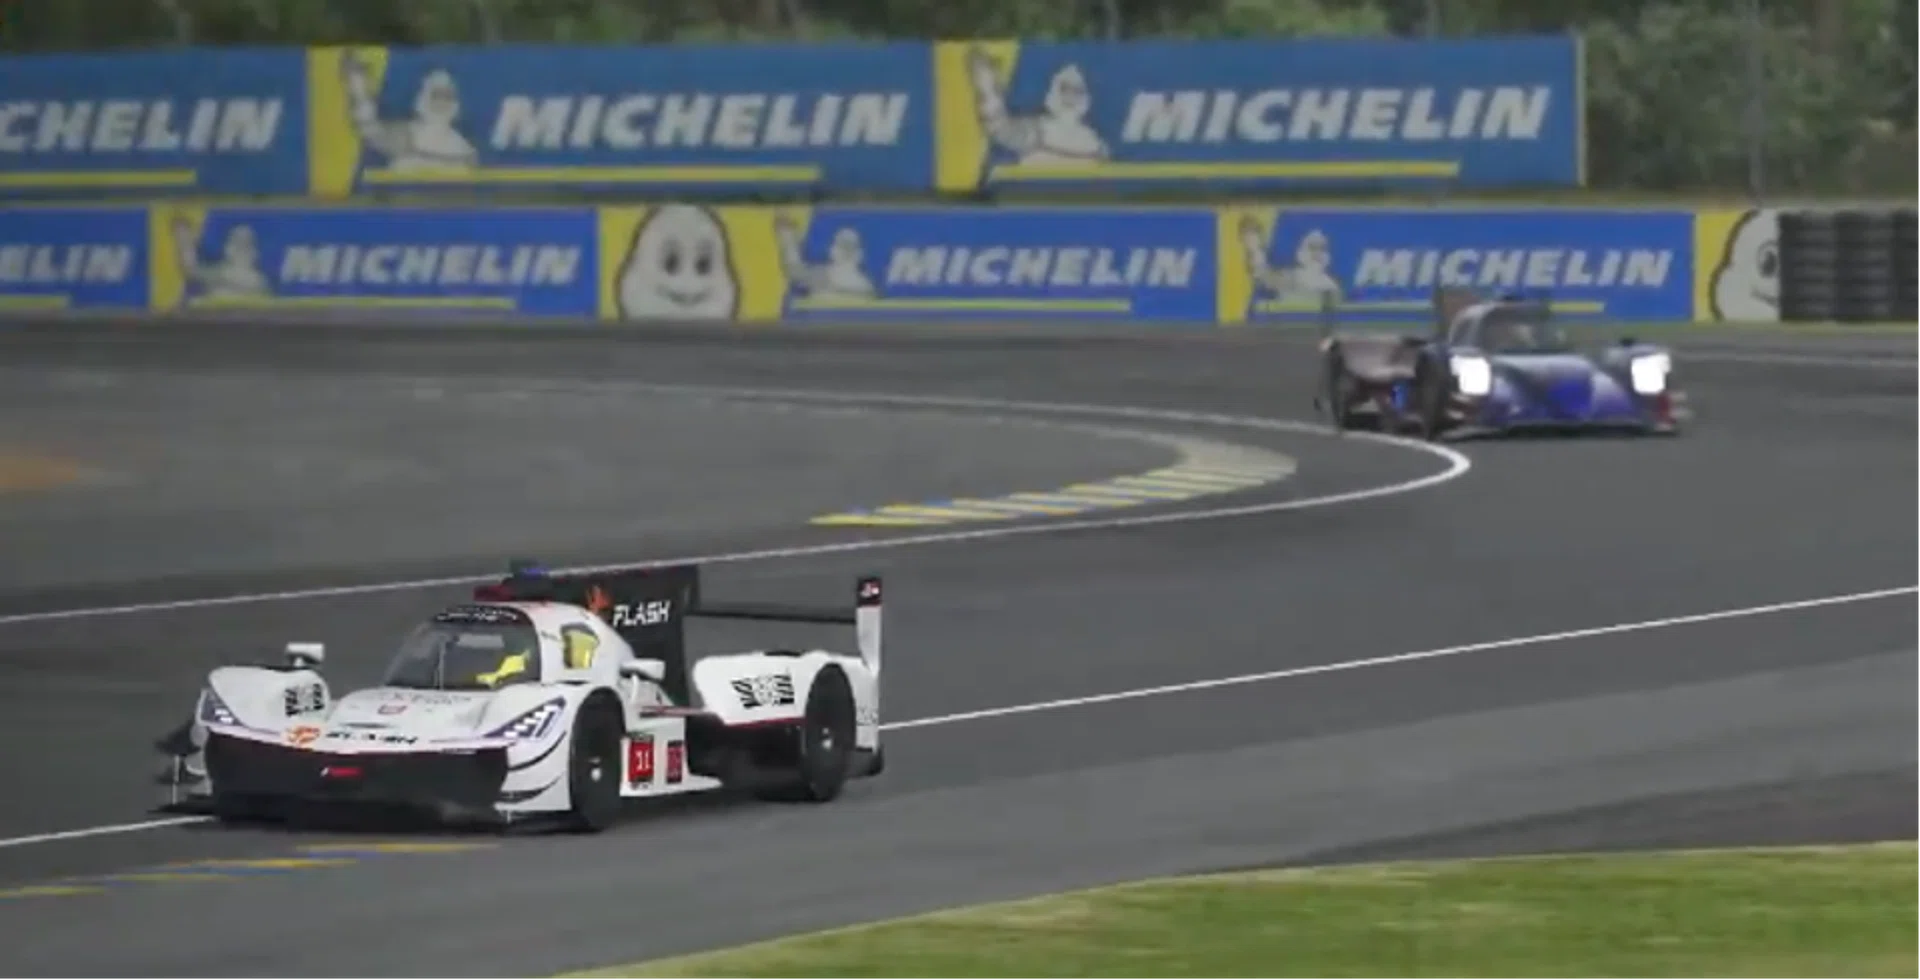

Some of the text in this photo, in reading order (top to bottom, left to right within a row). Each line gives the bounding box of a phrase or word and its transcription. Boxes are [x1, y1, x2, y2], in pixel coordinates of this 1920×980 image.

[491, 93, 908, 150] MICHELIN
[1122, 86, 1550, 142] MICHELIN
[280, 246, 581, 284] MICHELIN
[887, 247, 1196, 286] MICHELIN
[1353, 249, 1672, 288] MICHELIN
[613, 600, 671, 627] FLASH
